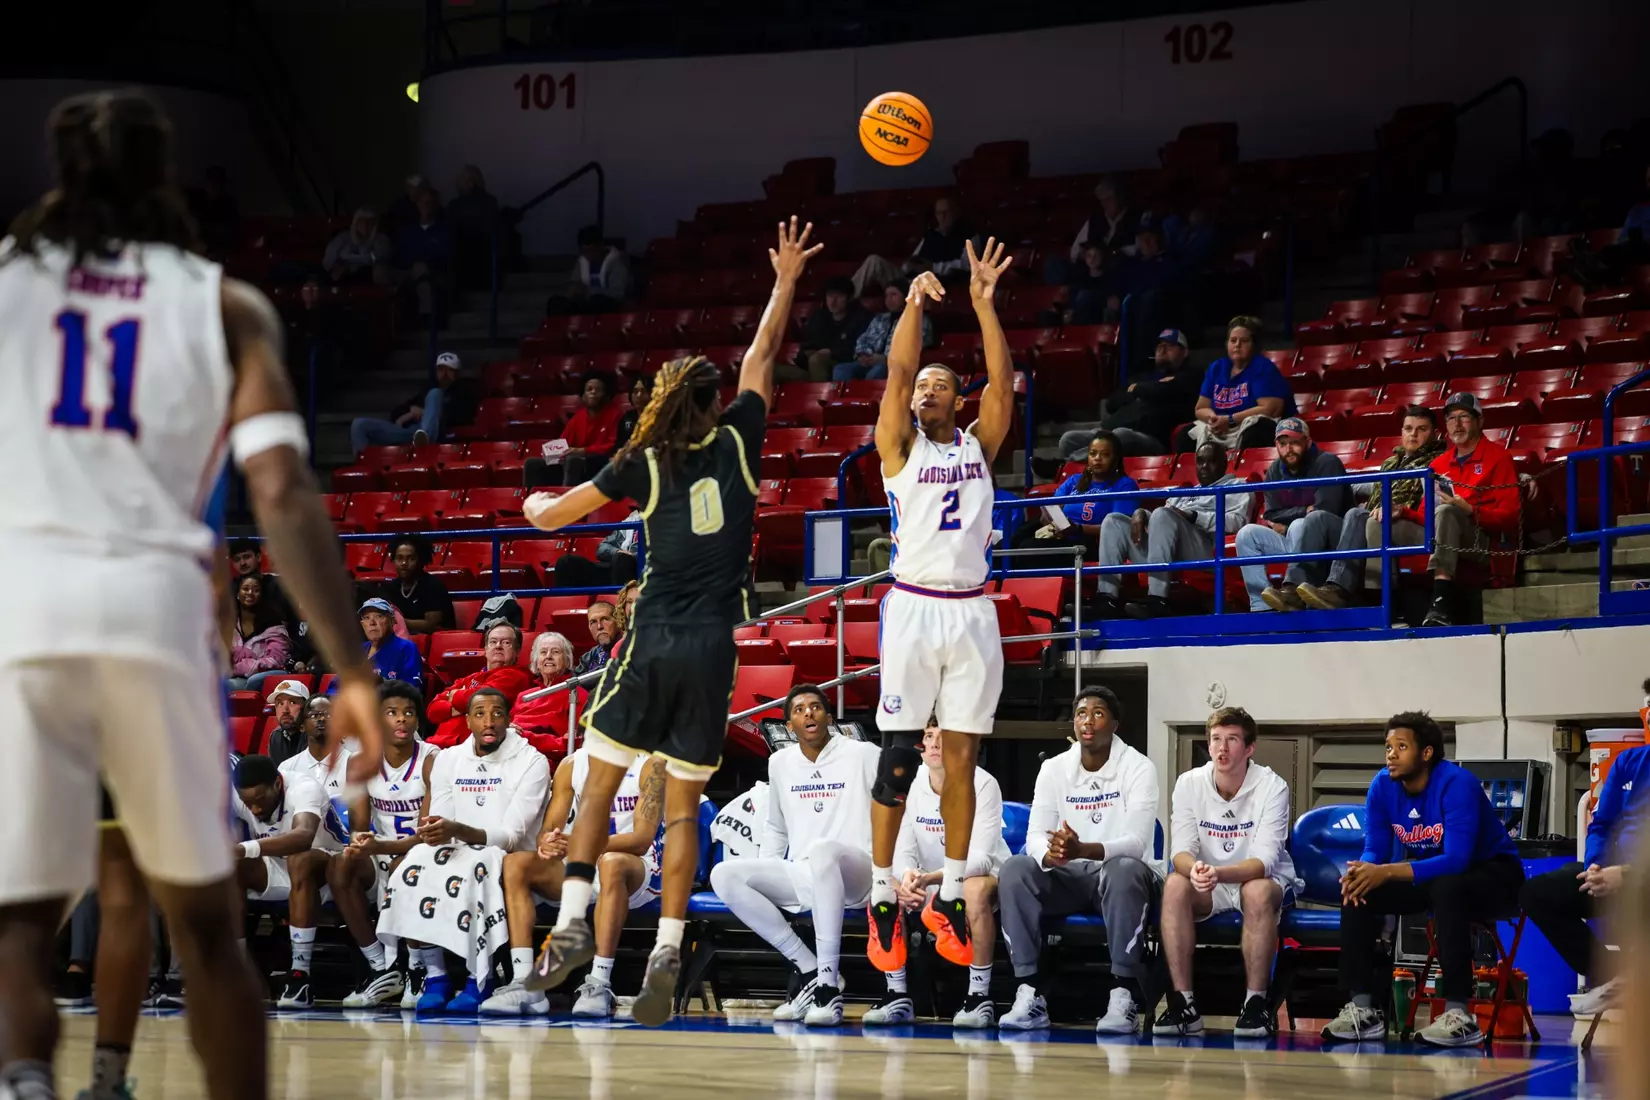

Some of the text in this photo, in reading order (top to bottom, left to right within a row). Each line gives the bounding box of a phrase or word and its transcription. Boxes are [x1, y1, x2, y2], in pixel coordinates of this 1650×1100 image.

[1164, 21, 1234, 65] 102
[514, 73, 576, 111] 101
[877, 103, 922, 131] Wilson
[874, 127, 910, 148] NCAA
[48, 305, 142, 442] 11
[689, 476, 725, 536] 0
[939, 488, 962, 531] 2
[1081, 501, 1096, 521] 5
[790, 782, 846, 793] LOUISIANA TECH
[1199, 820, 1239, 832] LOUISIANA
[434, 846, 456, 866] G
[402, 864, 423, 887] G
[445, 875, 464, 898] G
[419, 896, 438, 919] G
